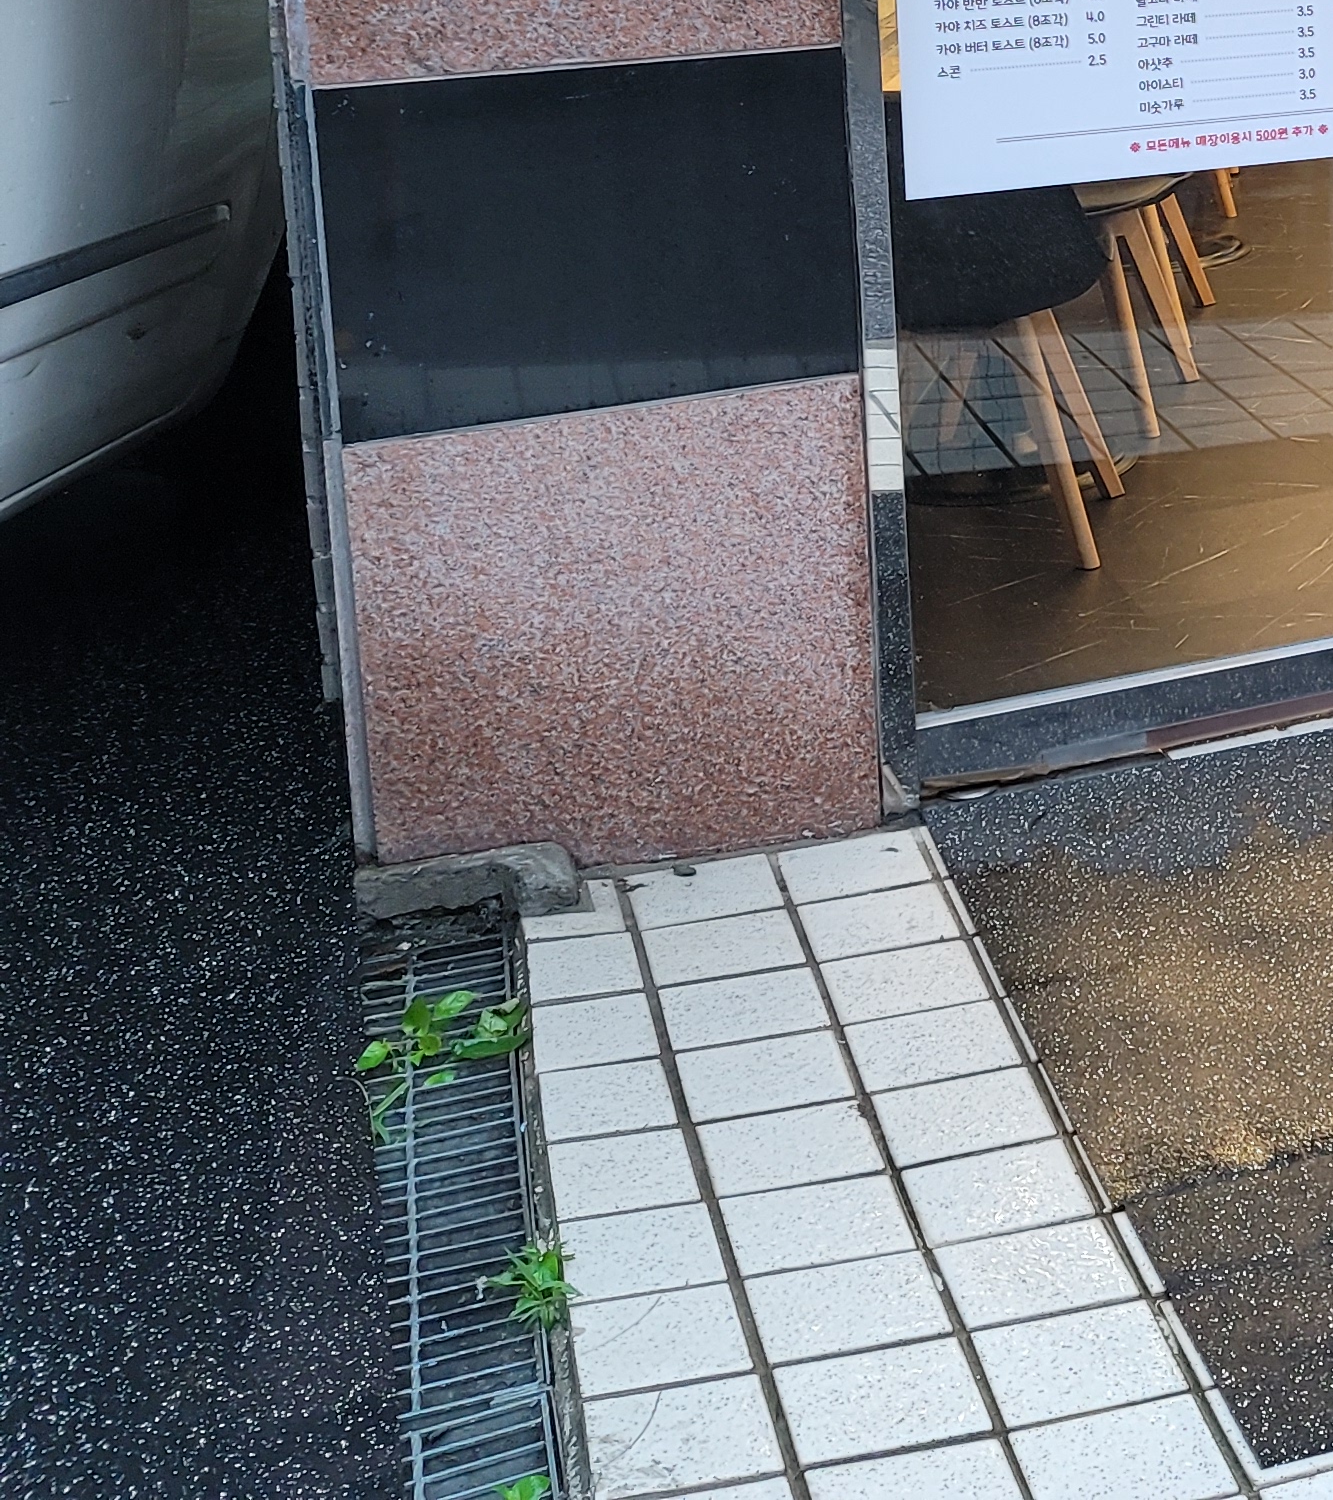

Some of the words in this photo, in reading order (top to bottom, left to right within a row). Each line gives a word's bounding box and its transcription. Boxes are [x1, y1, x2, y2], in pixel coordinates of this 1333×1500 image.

[935, 21, 960, 33] 카야
[964, 19, 987, 31] 치즈
[991, 16, 1025, 29] 토스트
[1028, 12, 1068, 29] (8조각)
[1086, 10, 1105, 22] 4.0
[1136, 14, 1170, 28] 그린티
[1172, 12, 1196, 24] 라떼
[1296, 5, 1314, 17] 3.5
[936, 43, 961, 55] 카야
[965, 41, 988, 54] 버터
[991, 38, 1025, 51] 토스트
[1029, 34, 1069, 51] (8조각)
[1087, 32, 1106, 45] 5.0
[1136, 35, 1171, 48] 고구마
[1174, 34, 1198, 46] 라떼
[1297, 26, 1315, 38] 3.5
[937, 65, 961, 79] 스콘
[1088, 54, 1107, 67] 2.5
[1138, 57, 1173, 72] 아샷추
[1298, 47, 1315, 59] 3.5
[1138, 77, 1184, 92] 아이스티
[1298, 68, 1316, 80] 3.0
[1139, 98, 1185, 115] 미숫가루
[1299, 89, 1317, 100] 3.5
[1145, 137, 1191, 152] 모든메뉴
[1195, 130, 1251, 147] 매장이용시
[1255, 127, 1288, 142] 500원
[1292, 125, 1313, 138] 추가
